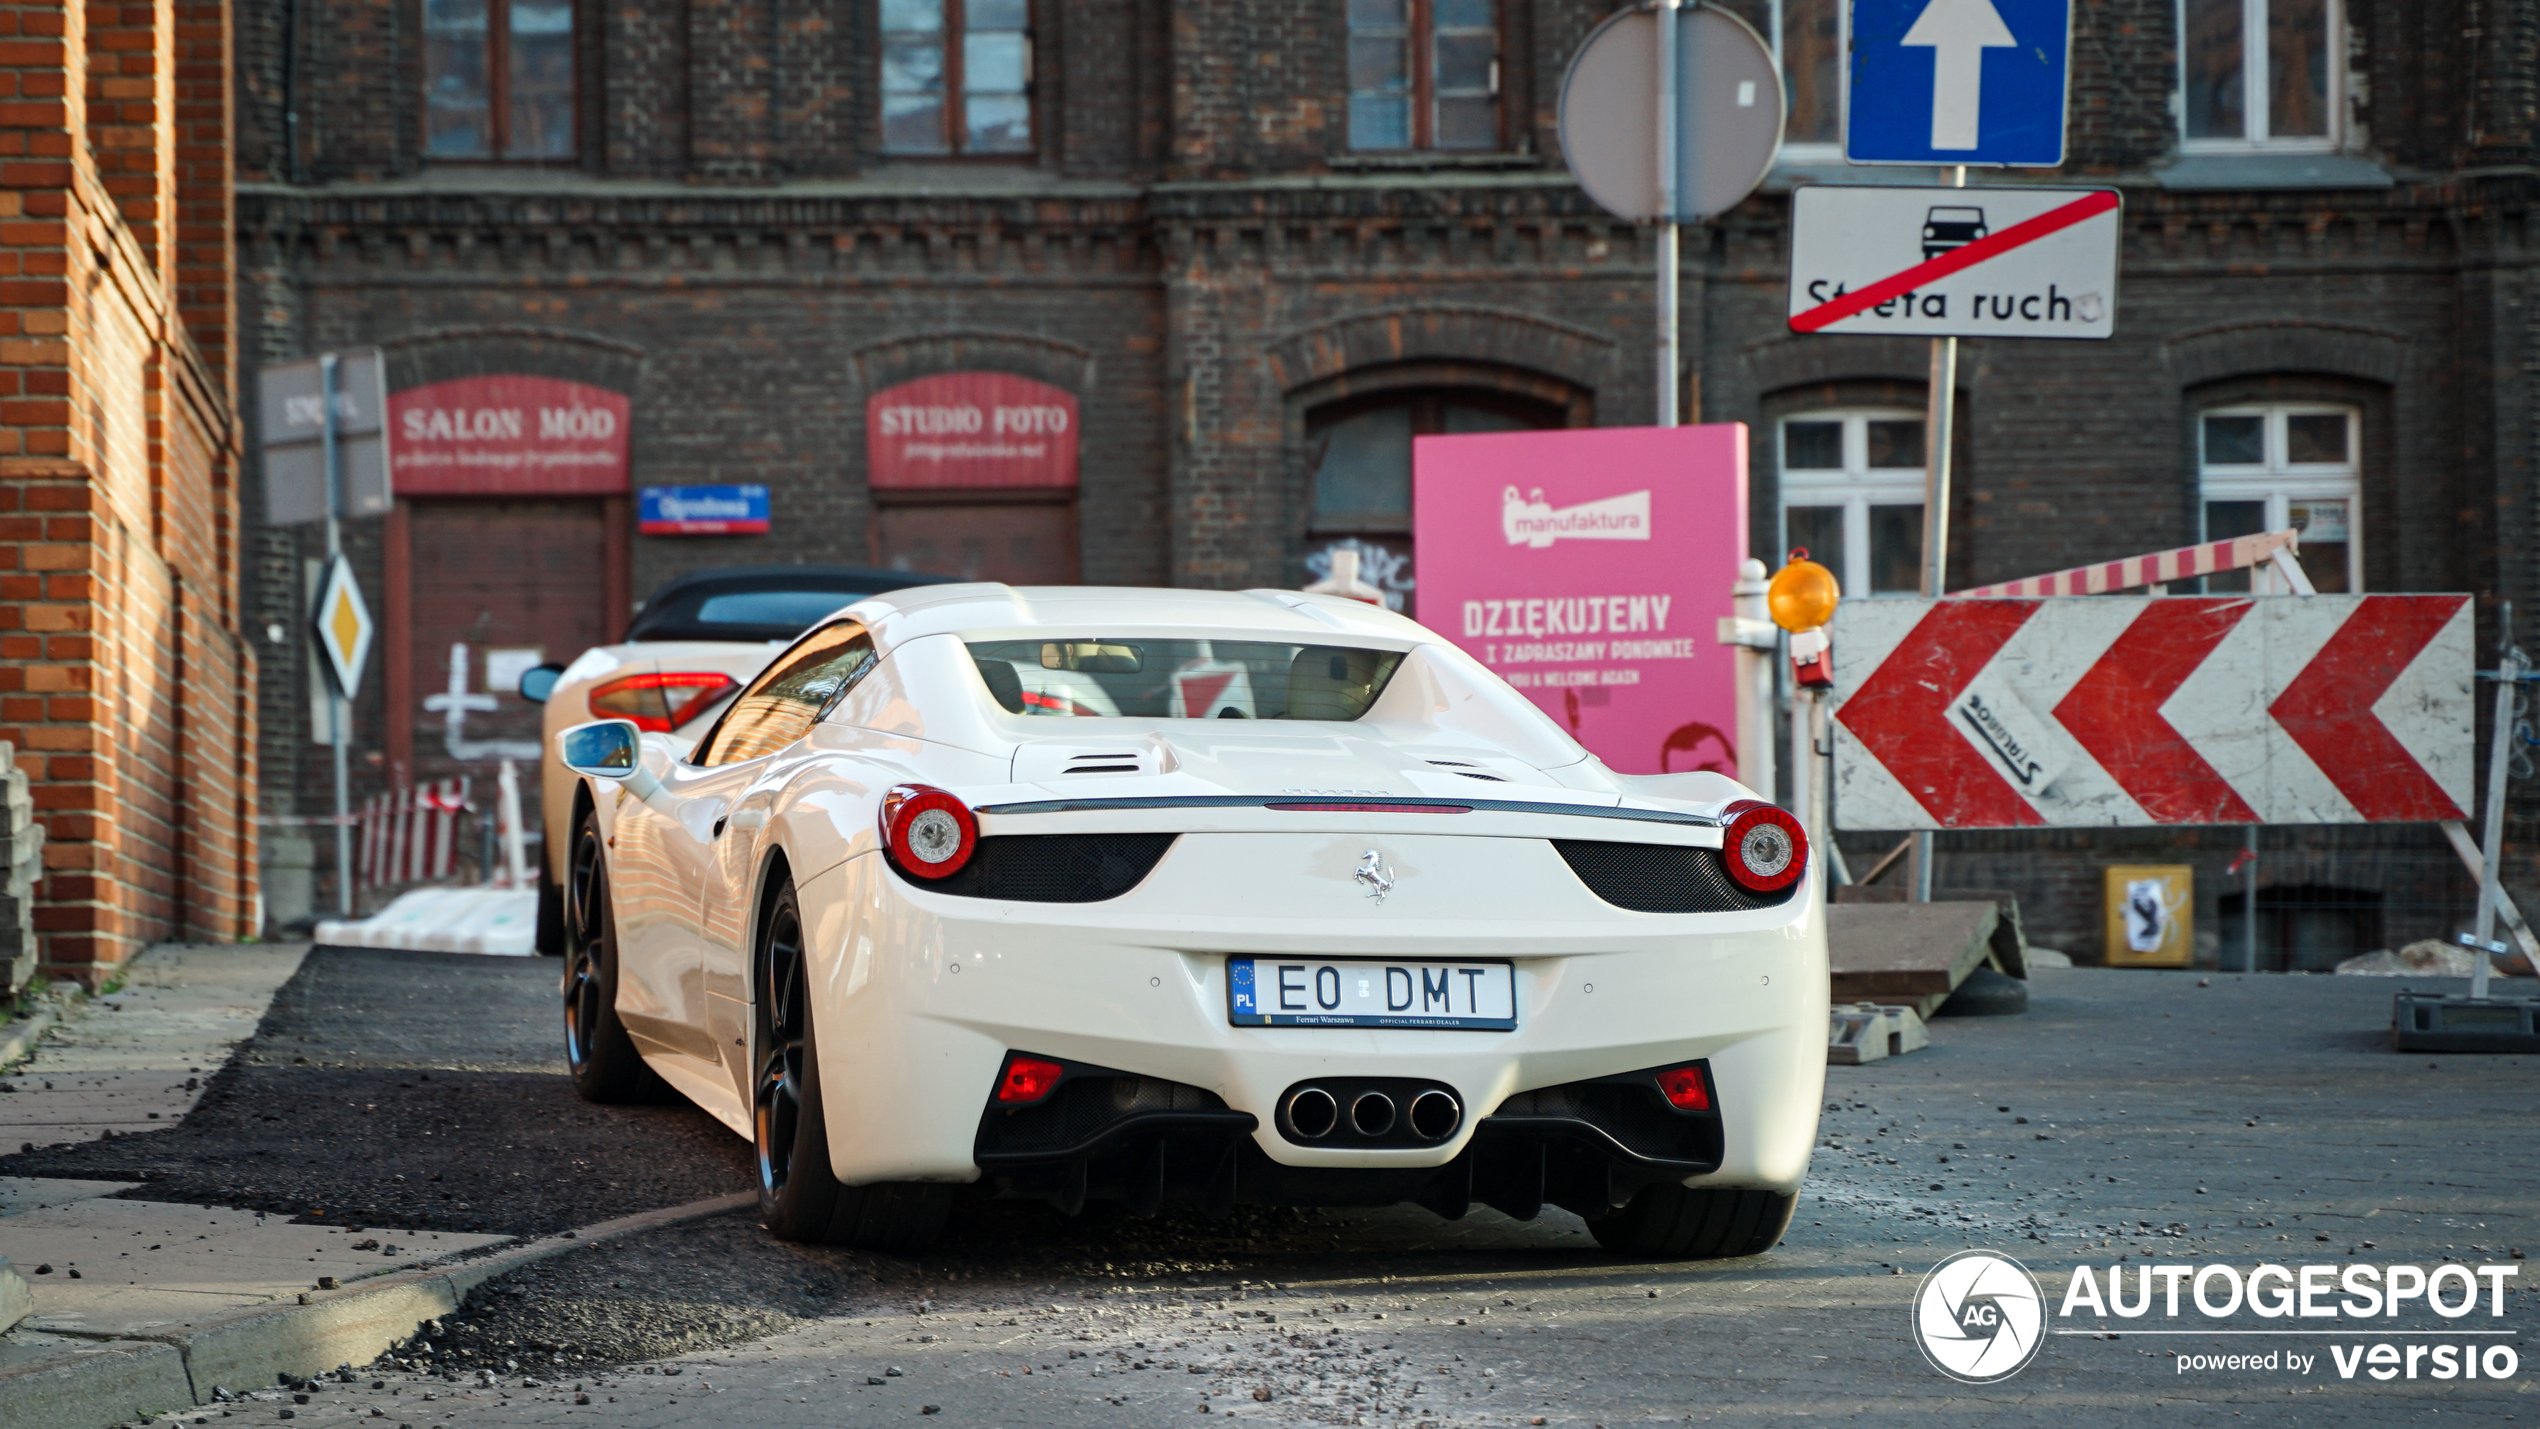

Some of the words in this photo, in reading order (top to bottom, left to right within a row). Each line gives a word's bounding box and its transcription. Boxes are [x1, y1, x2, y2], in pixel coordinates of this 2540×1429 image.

[1973, 284, 2101, 322] ruch
[402, 408, 522, 441] SALON
[879, 404, 982, 435] STUDIO
[993, 404, 1069, 435] FOTO
[1515, 510, 1641, 534] manufaktura
[1463, 595, 1672, 640] DZIĘKUJEMY
[1486, 645, 1498, 664] I
[1503, 642, 1606, 662] ZAPRASZAMY
[1611, 638, 1694, 660] PONOWNIE
[1544, 670, 1598, 687] WELCOME
[1600, 669, 1638, 685] AGAIN
[1236, 994, 1254, 1008] PL
[1386, 967, 1485, 1013] DMT
[1296, 1016, 1319, 1024] Ferrari
[1321, 1016, 1354, 1024] Warszawa
